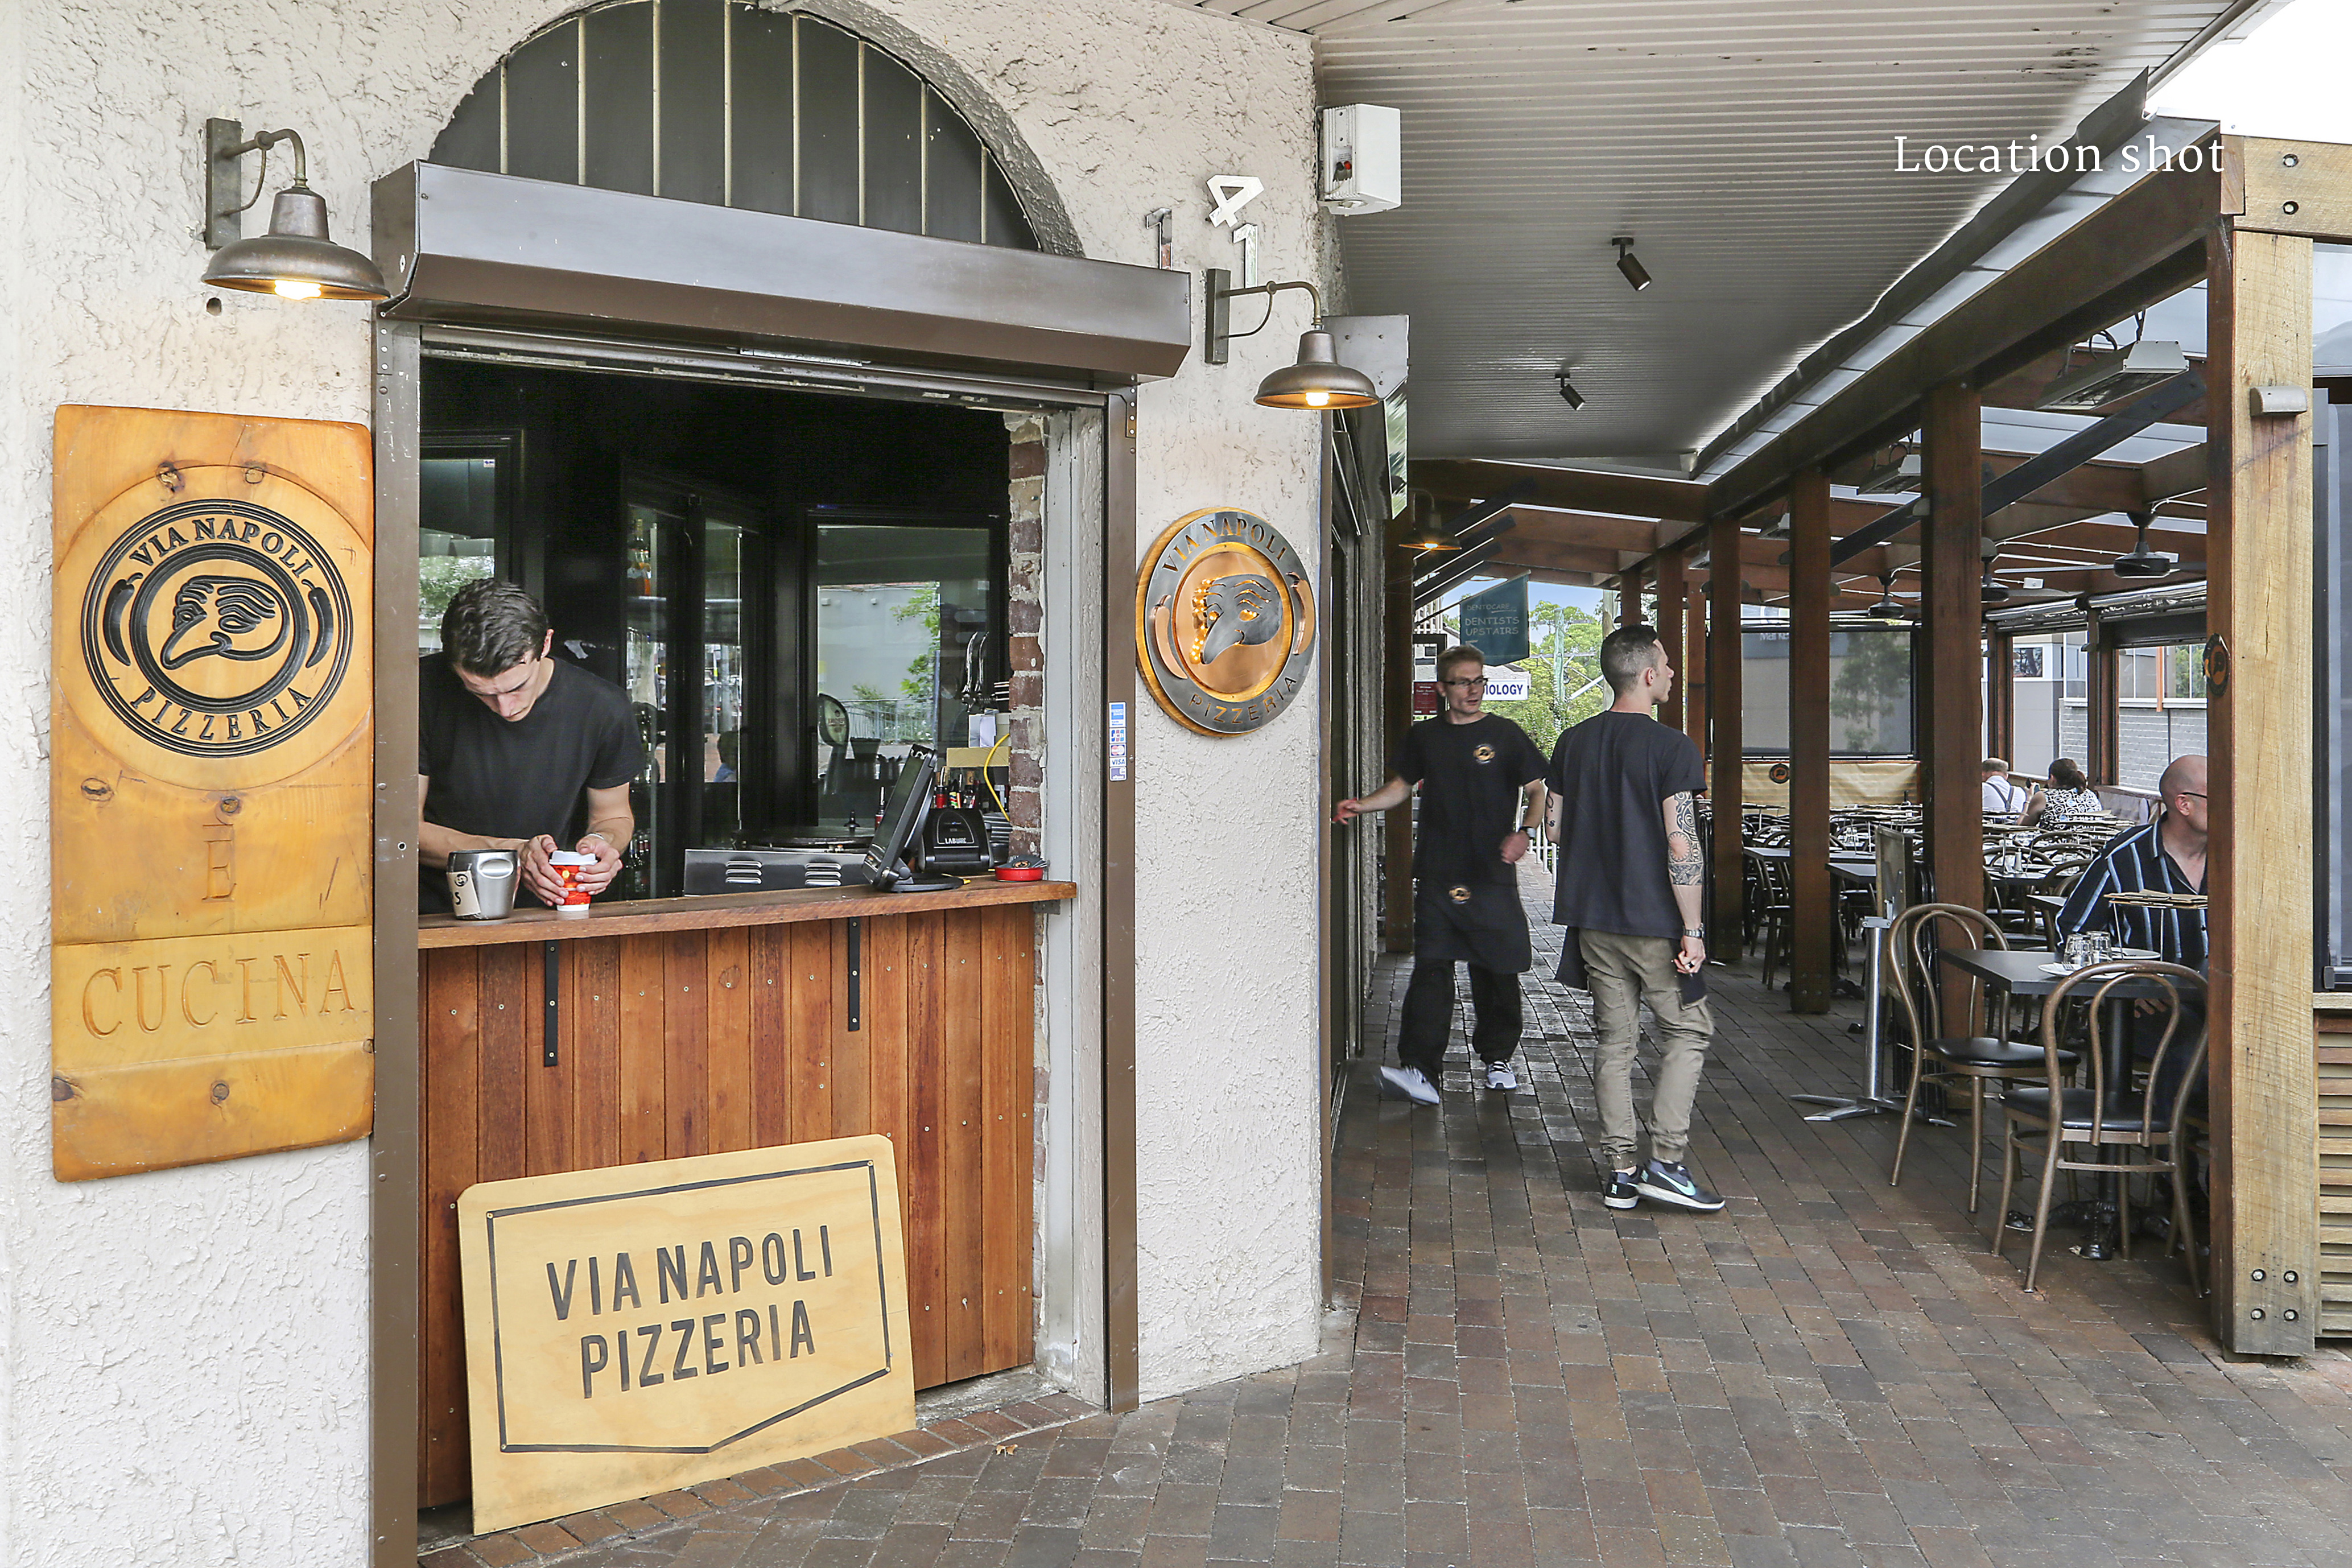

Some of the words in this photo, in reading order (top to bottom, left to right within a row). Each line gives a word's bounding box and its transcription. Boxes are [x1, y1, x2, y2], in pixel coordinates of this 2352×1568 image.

[130, 527, 189, 567] VIA
[193, 517, 313, 579] NAPOLI
[1162, 534, 1200, 573] VIA
[1201, 518, 1288, 561] NAPOLI
[1465, 617, 1520, 626] DENTISTS
[1465, 627, 1519, 636] UPSTAIRS
[130, 686, 312, 741] PIZZERIA
[1189, 676, 1297, 724] PIZZERIA
[82, 950, 355, 1040] CUCINA
[546, 1252, 642, 1321] VIA
[657, 1224, 833, 1304] NAPOLI
[580, 1299, 816, 1400] PIZZERIA
